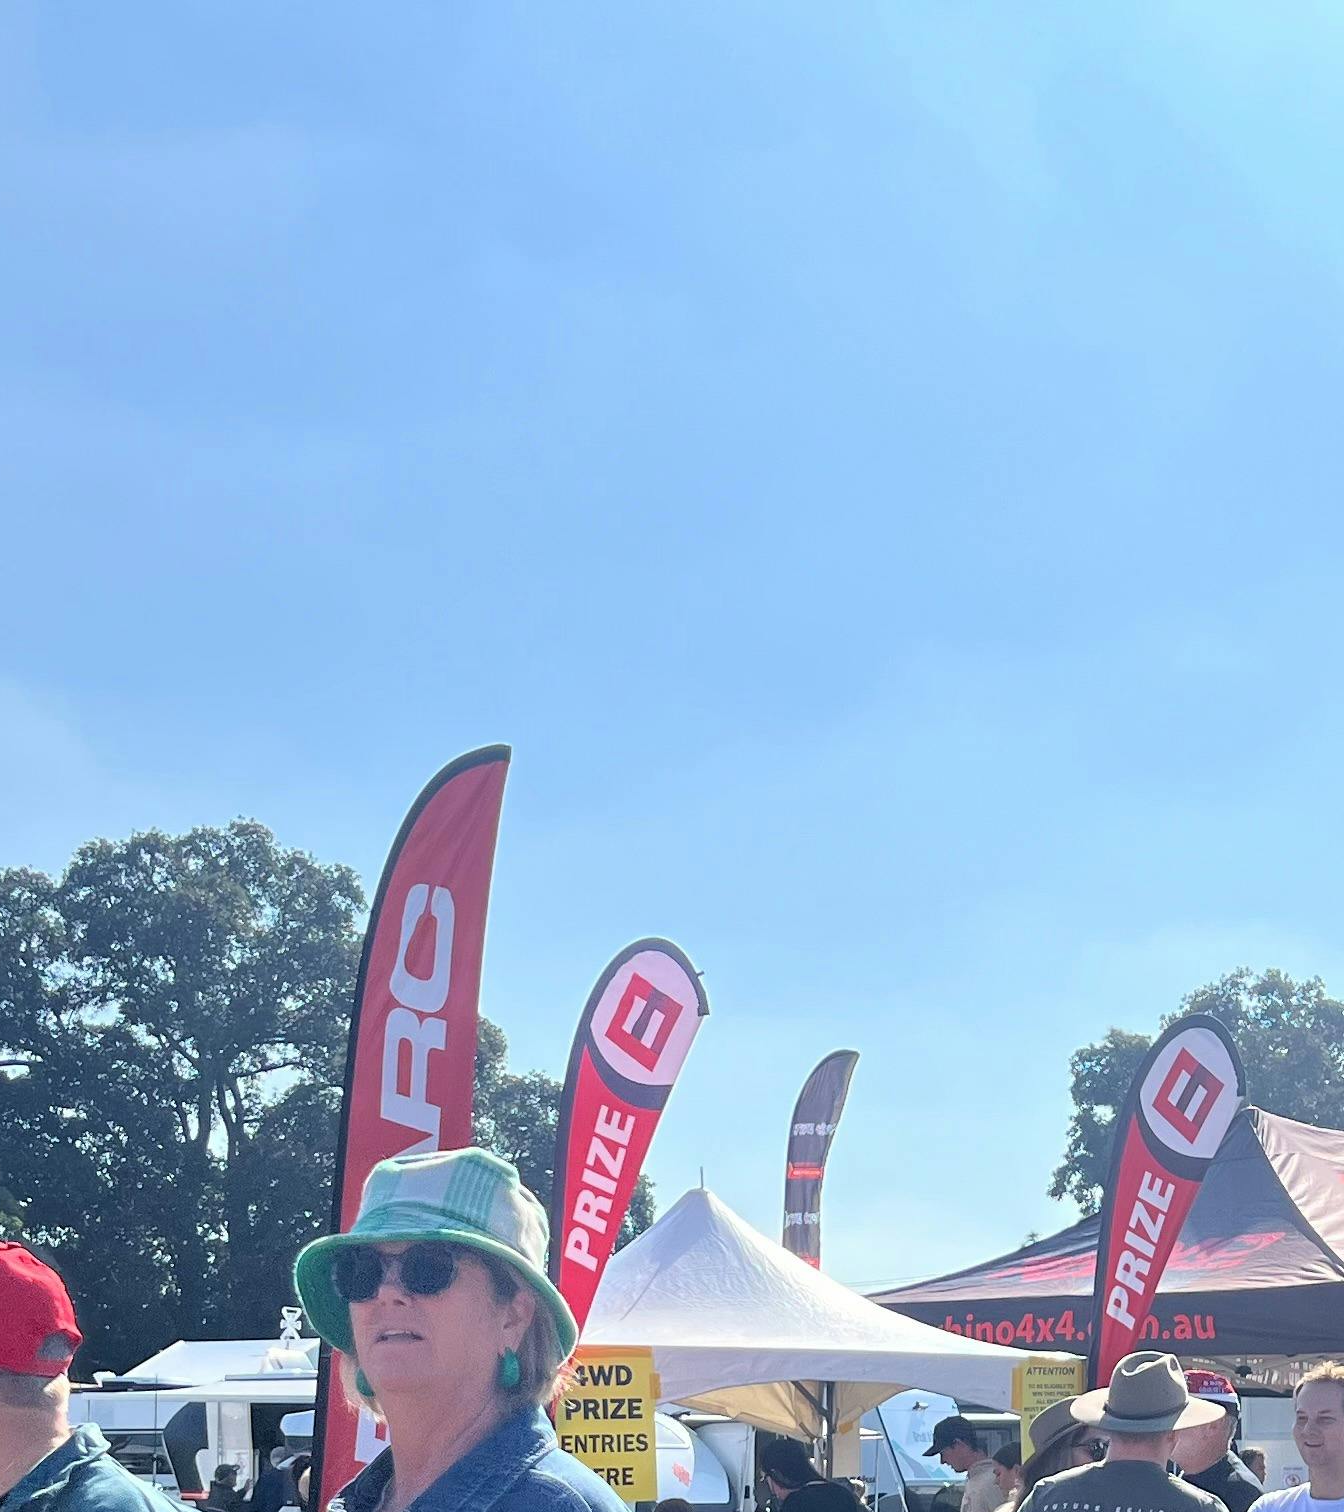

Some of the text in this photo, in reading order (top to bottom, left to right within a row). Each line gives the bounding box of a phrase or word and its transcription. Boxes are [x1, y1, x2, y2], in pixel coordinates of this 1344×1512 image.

[564, 1104, 636, 1272] PRIZE
[1106, 1171, 1176, 1331] PRIZE
[939, 1309, 1216, 1345] hino4x4.m.au
[573, 1364, 633, 1387] 4WD
[1026, 1366, 1076, 1376] ATTENTION
[564, 1397, 644, 1421] PRIZE
[560, 1433, 649, 1453] ENTRIES
[592, 1466, 635, 1487] ERE
[1043, 1502, 1101, 1512] FUTURE
